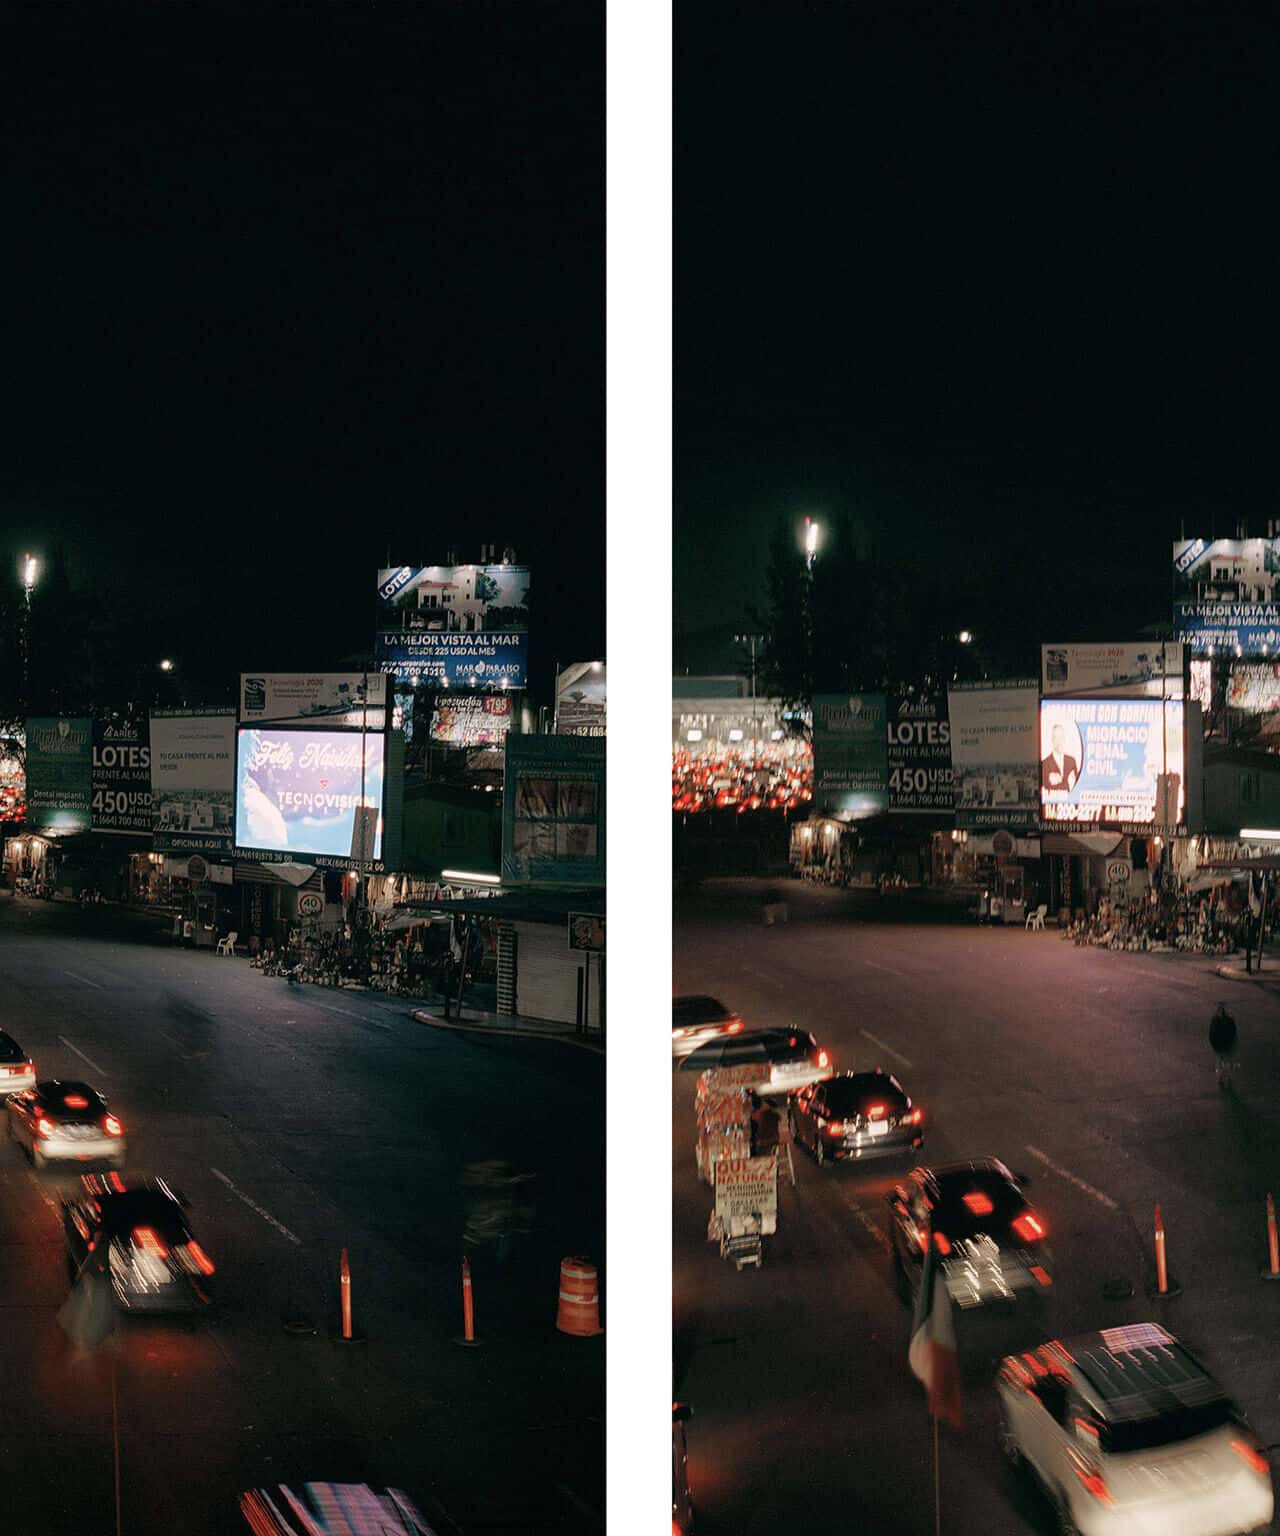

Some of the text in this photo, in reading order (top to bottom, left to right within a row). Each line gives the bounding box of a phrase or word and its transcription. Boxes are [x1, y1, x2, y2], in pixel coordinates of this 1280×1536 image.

[380, 567, 412, 600] LOTES
[1197, 606, 1232, 616] MEJOR
[1233, 606, 1263, 616] VISTA
[1265, 606, 1278, 616] AL
[385, 635, 519, 645] LA MEJOR VISTA AL MAR
[450, 647, 466, 655] USD
[887, 721, 950, 744] LOTES
[92, 746, 150, 768] LOTES
[216, 752, 229, 760] MAR
[256, 741, 293, 770] Feliz
[1087, 760, 1117, 775] CIVIL
[92, 770, 150, 779] FRENTE AL MAR
[889, 768, 954, 793] 450 USD
[92, 791, 152, 813] 450 USD
[171, 838, 204, 847] OFICINAS
[1110, 866, 1125, 877] 40
[304, 898, 317, 908] 40
[717, 1158, 775, 1175] QUE
